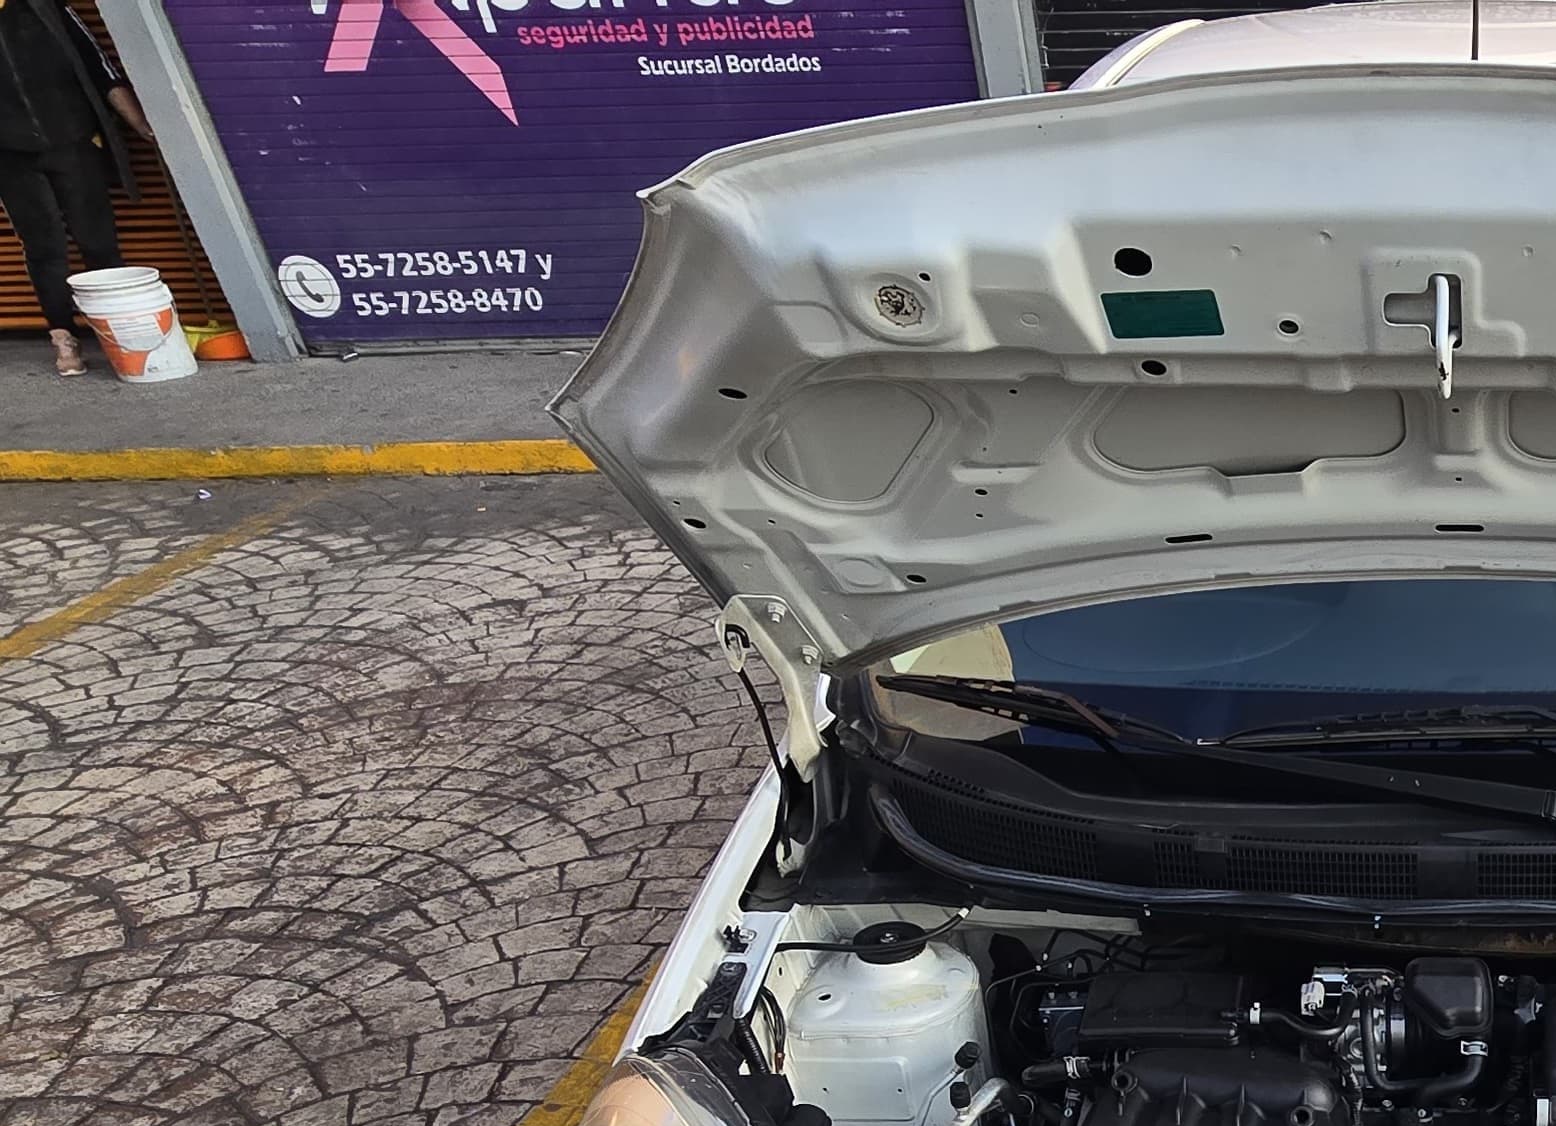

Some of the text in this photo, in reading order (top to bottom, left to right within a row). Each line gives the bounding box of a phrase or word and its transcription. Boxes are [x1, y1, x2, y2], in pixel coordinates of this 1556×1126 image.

[516, 18, 648, 48] seguridad
[653, 22, 668, 46] y
[676, 14, 815, 45] publicidad
[638, 53, 822, 76] Sucursal Bordados
[335, 249, 552, 280] 55-7258-5147 y
[352, 287, 543, 316] 55-7258-8470
